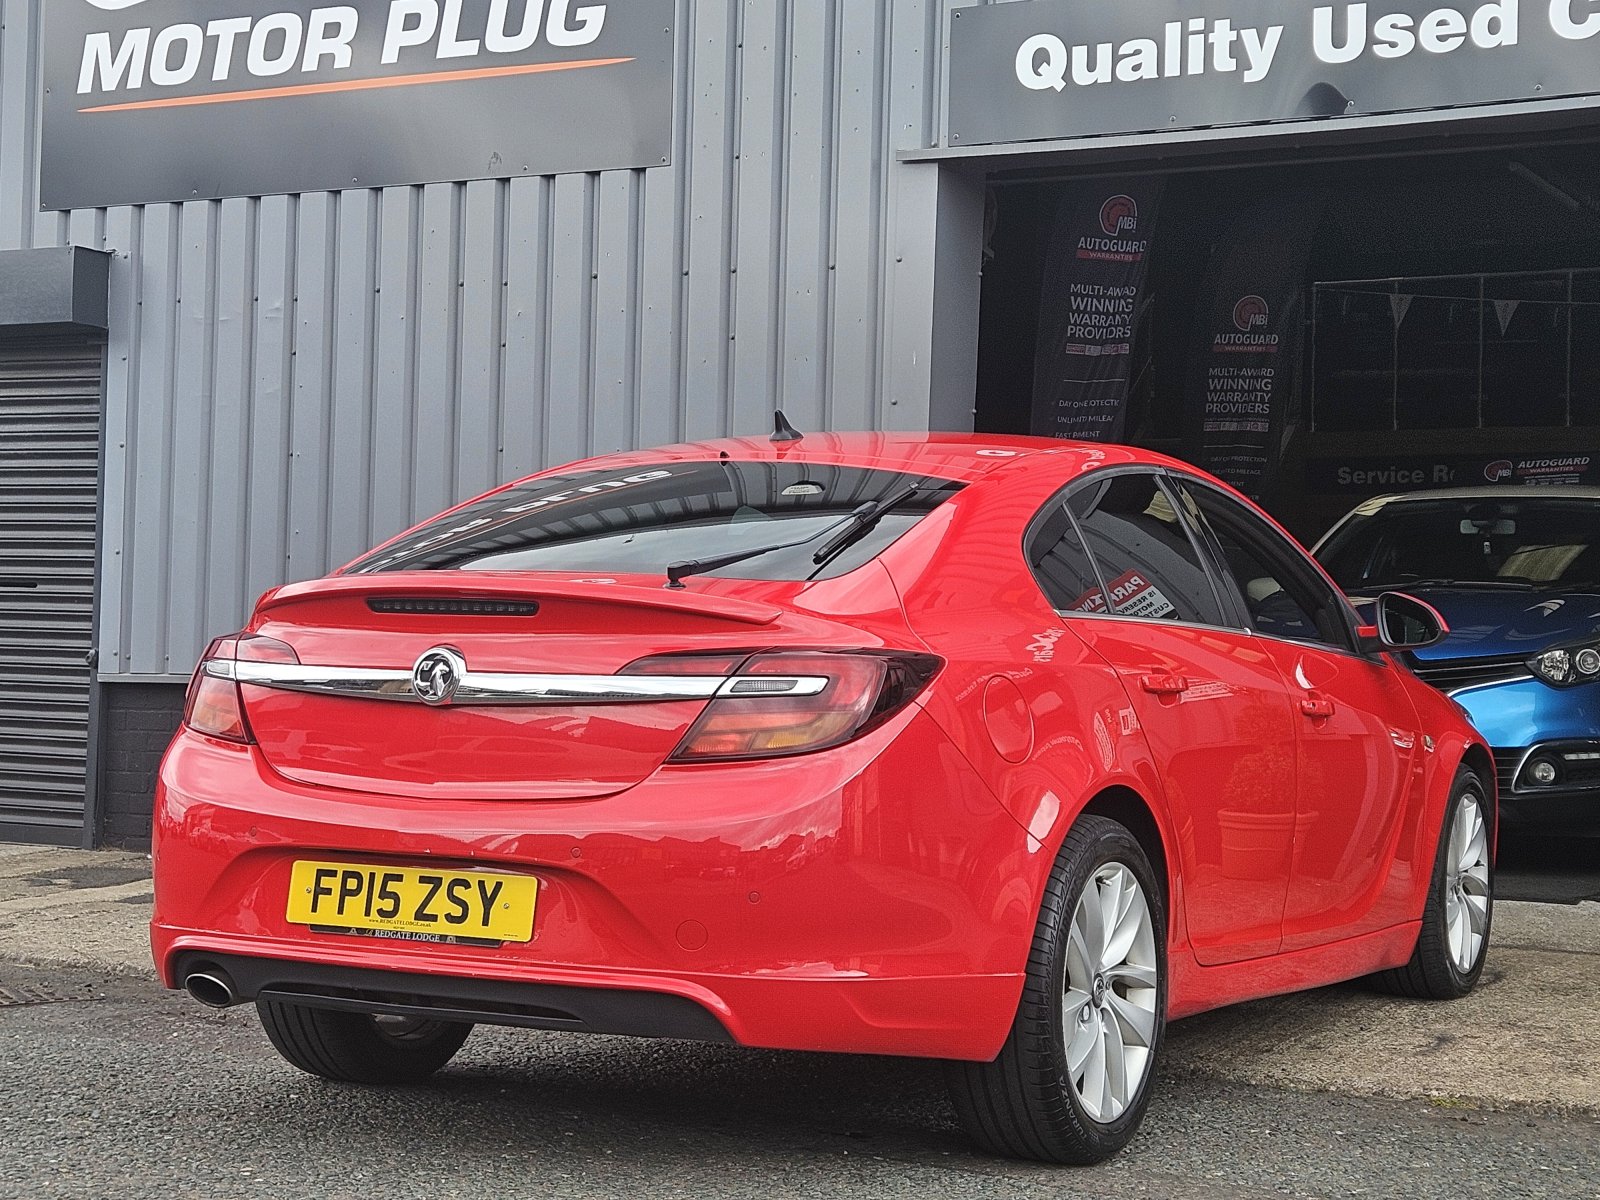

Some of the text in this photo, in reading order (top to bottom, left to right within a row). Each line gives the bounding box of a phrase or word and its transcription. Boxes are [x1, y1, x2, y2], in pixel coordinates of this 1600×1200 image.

[76, 0, 606, 94] MOTOR PLUG
[1015, 18, 1284, 93] Quality
[1312, 0, 1520, 64] Used
[1077, 236, 1147, 253] AUTOGUARD
[1070, 296, 1134, 313] WINNING
[1067, 325, 1132, 340] PROVIDRS
[1213, 333, 1279, 345] AUTOGUARD
[1208, 367, 1275, 377] MULTI-AWARD
[1208, 378, 1272, 391] WINNING
[1058, 399, 1072, 407] DAY
[1207, 391, 1272, 403] WARRANTY
[1205, 402, 1270, 414] PROVIDERS
[1517, 456, 1590, 469] AUTOGUARD
[1336, 466, 1425, 485] Service
[1529, 466, 1574, 474] WARRANTIES
[310, 868, 504, 927] FP15 ZSY
[374, 929, 440, 942] REDGATE LODGE
[1058, 1074, 1088, 1142] TURANZA
